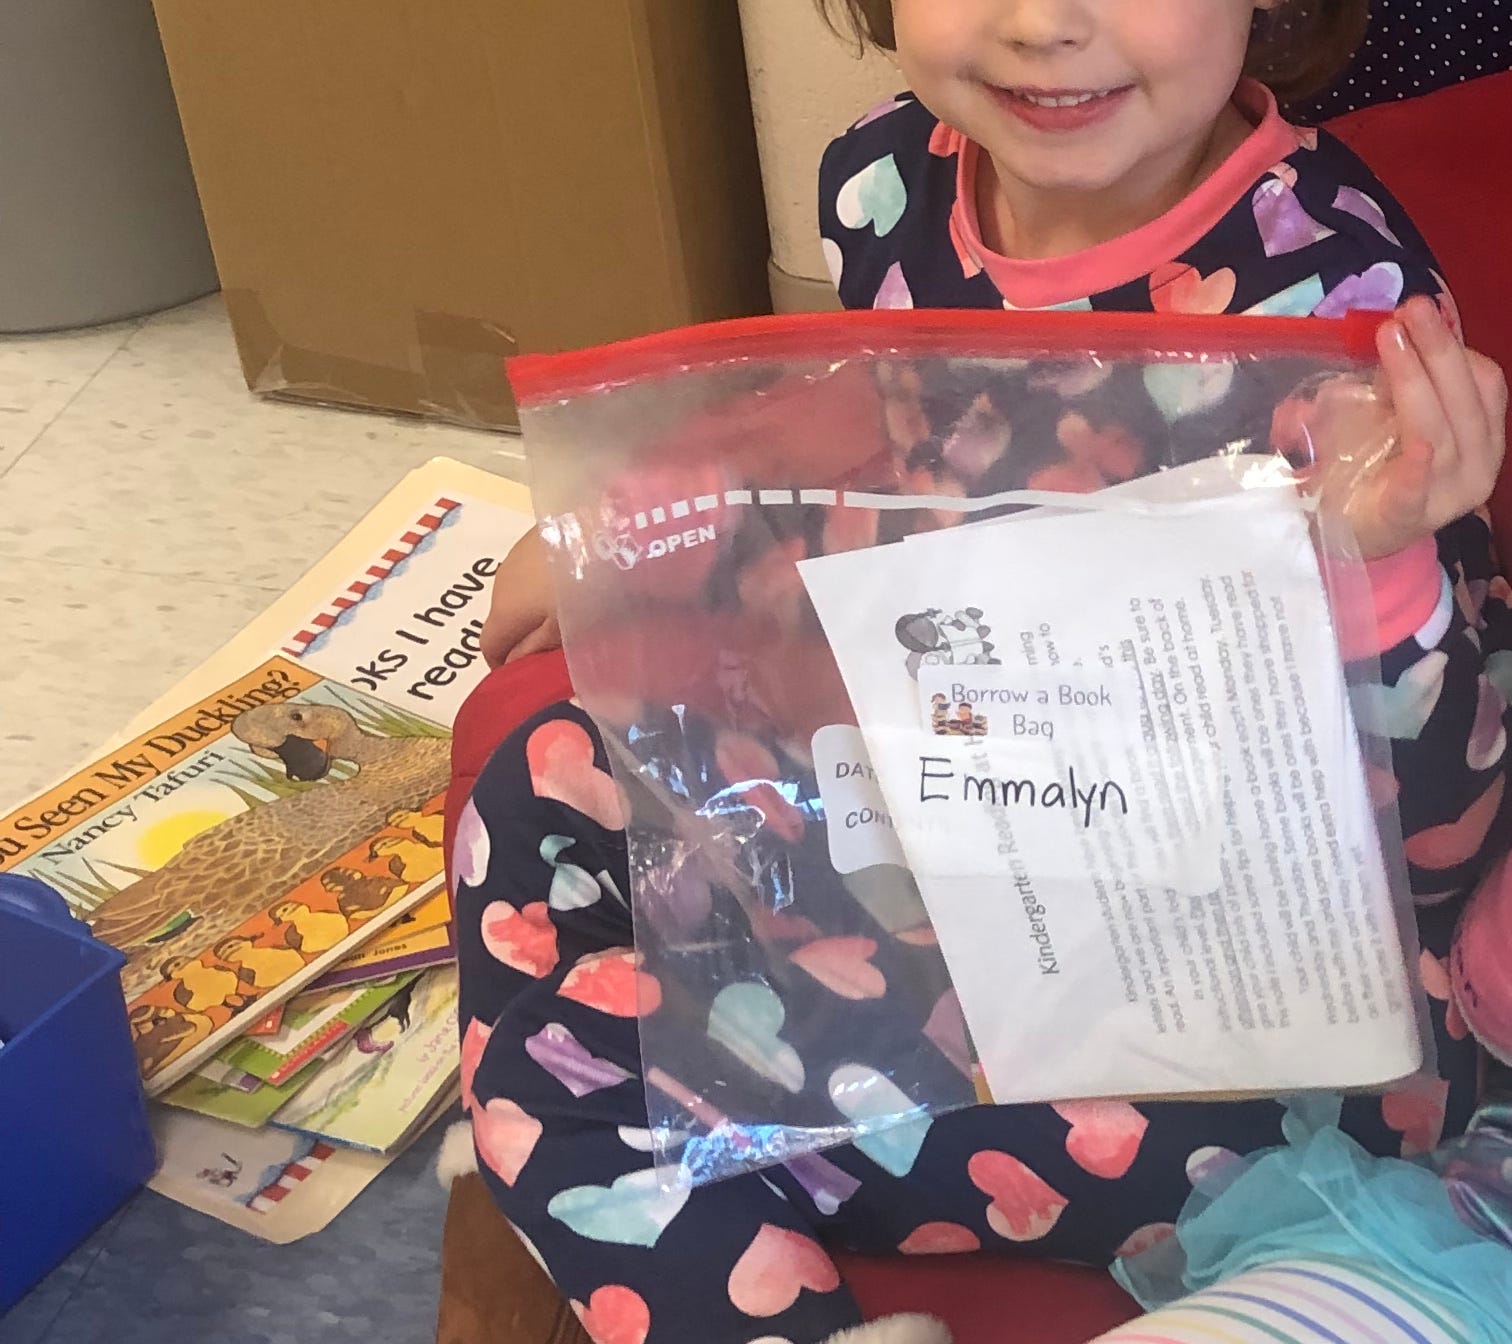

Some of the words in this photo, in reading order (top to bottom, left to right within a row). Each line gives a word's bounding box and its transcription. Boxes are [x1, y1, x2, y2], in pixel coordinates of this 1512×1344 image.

[649, 524, 716, 558] OPEN
[1220, 575, 1237, 608] read
[1241, 569, 1255, 588] for
[395, 629, 430, 644] I
[413, 557, 497, 627] have
[1129, 597, 1141, 613] to
[1147, 598, 1165, 612] of
[1270, 595, 1285, 621] not
[1135, 615, 1151, 644] sure
[1156, 615, 1175, 653] back
[1175, 598, 1193, 643] home.
[1231, 610, 1247, 649] have
[1143, 646, 1157, 665] Be
[1183, 645, 1199, 661] at
[1278, 623, 1294, 663] have
[1167, 654, 1180, 679] the
[1189, 664, 1207, 700] read
[1242, 651, 1255, 685] they
[1263, 657, 1279, 696] have
[951, 683, 1028, 704] Borrow
[1036, 689, 1049, 704] a
[1058, 685, 1112, 706] Book
[1173, 682, 1188, 705] On
[1249, 687, 1265, 722] ones
[1289, 673, 1312, 736] because
[1012, 713, 1054, 739] Bag
[1199, 702, 1216, 738] child
[1230, 705, 1249, 744] each
[1257, 724, 1271, 745] be
[14, 785, 110, 840] Seen
[91, 752, 162, 791] My
[144, 668, 300, 757] Duckling?
[1241, 746, 1258, 784] book
[1281, 732, 1297, 767] ones
[836, 761, 874, 780] DAT
[1289, 769, 1303, 789] be
[1311, 769, 1325, 801] help
[37, 804, 138, 866] Nancy
[134, 749, 229, 804] Tafuri
[919, 756, 1128, 828] Emmalyn
[1268, 772, 1287, 814] books
[1254, 799, 1270, 840] home
[1280, 816, 1296, 855] Some
[1301, 815, 1319, 857] books
[1320, 802, 1337, 838] extra
[1311, 858, 1329, 895] some
[1015, 858, 1060, 976] Kindergarten
[1319, 896, 1335, 924] and
